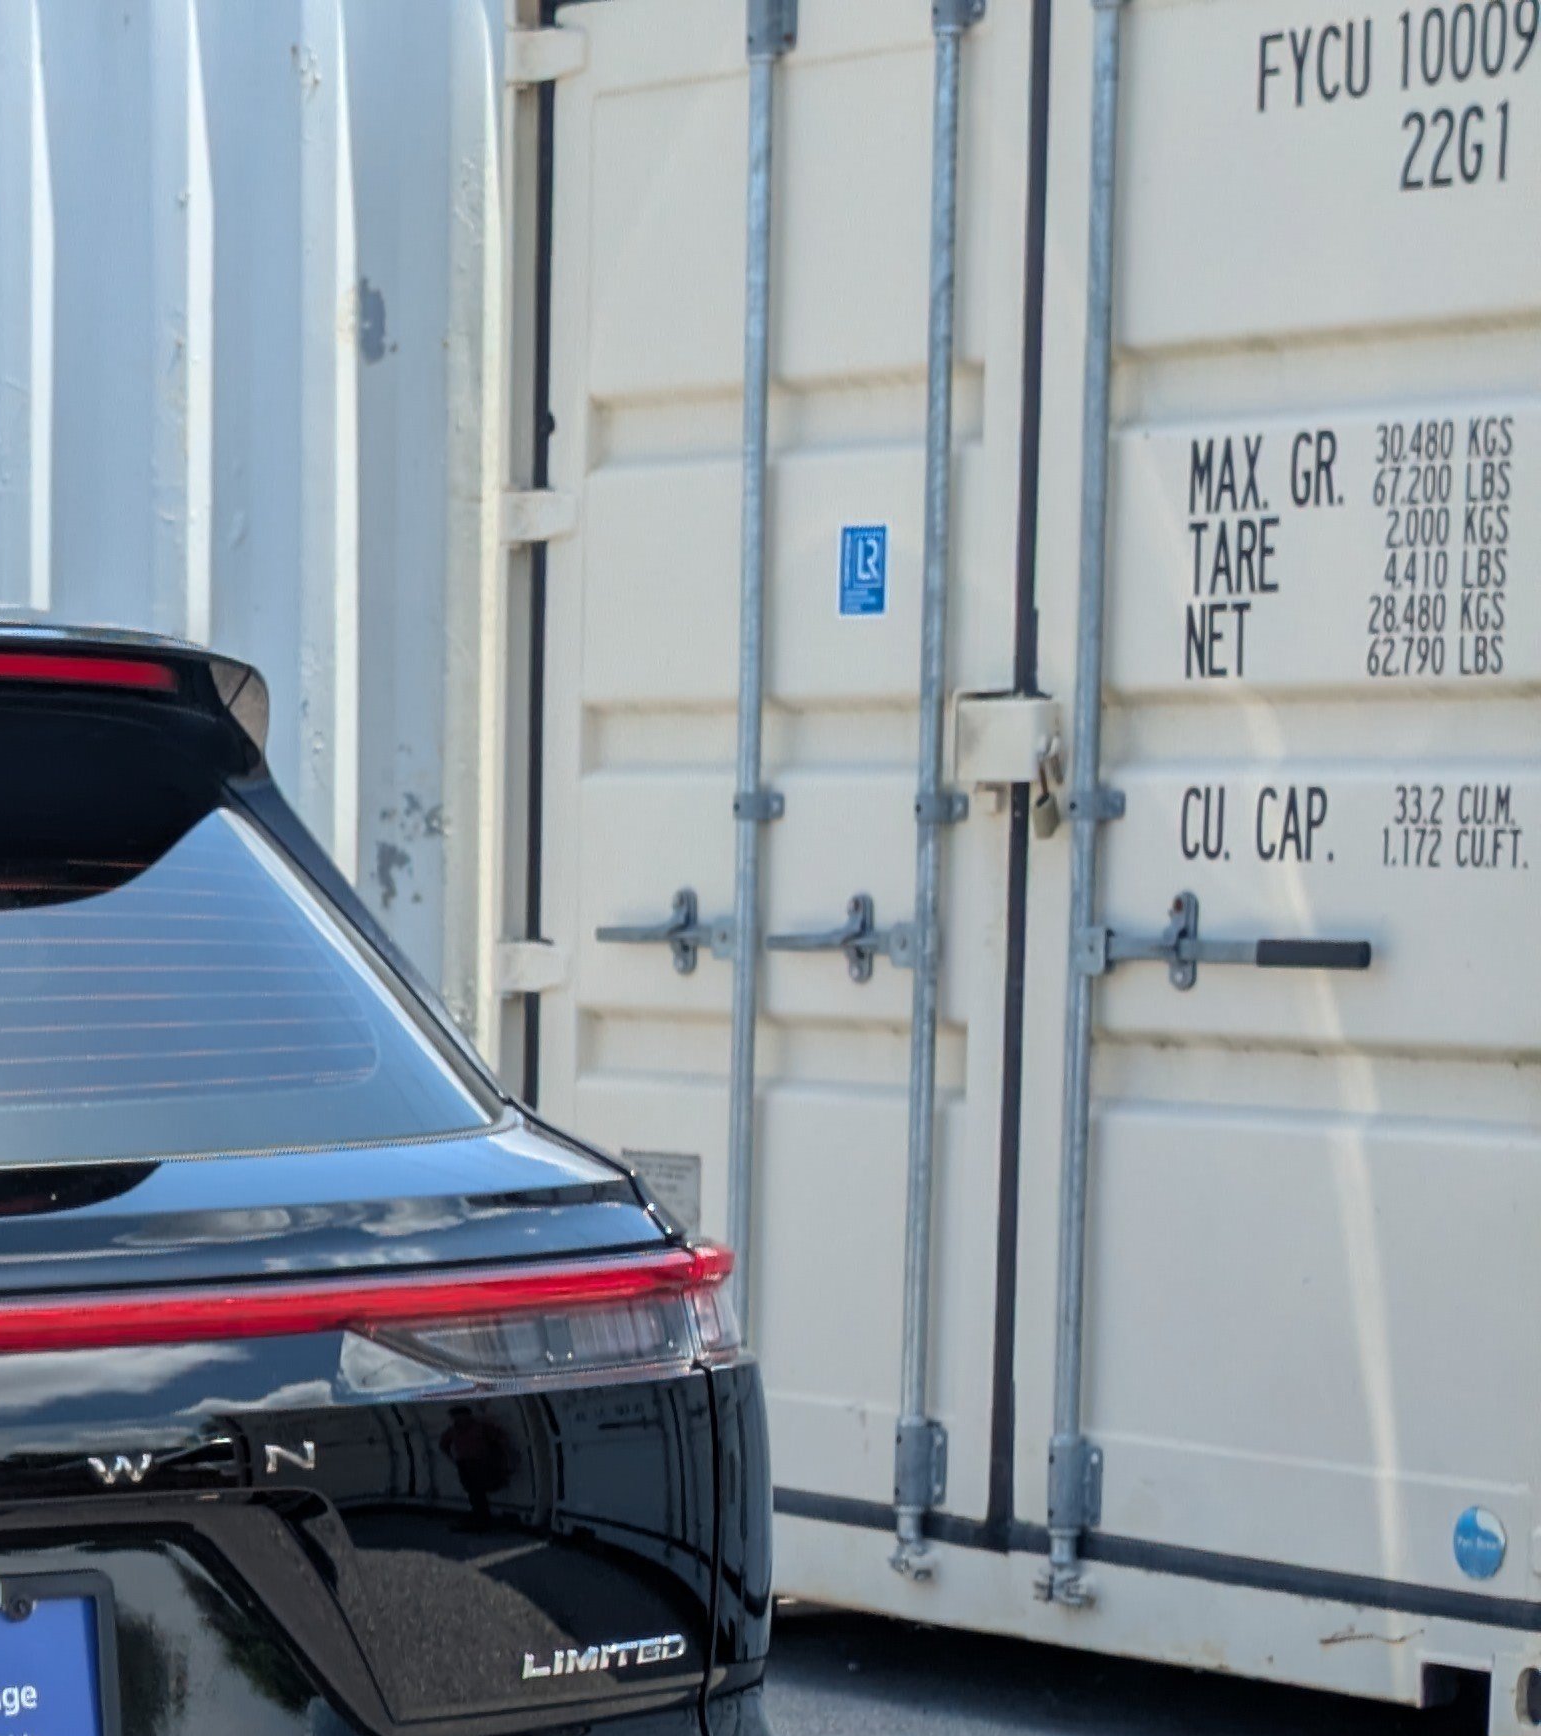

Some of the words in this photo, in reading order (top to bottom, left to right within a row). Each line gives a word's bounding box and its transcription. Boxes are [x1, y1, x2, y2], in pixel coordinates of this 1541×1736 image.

[1257, 16, 1373, 114] FYCU
[1399, 98, 1511, 192] 22G1
[1375, 419, 1454, 464] 30.480
[1467, 415, 1514, 457] KGS
[1188, 434, 1269, 514] MAX.
[1290, 429, 1344, 508] GR.
[1372, 463, 1452, 507] 67.200
[1465, 461, 1512, 503] LBS
[1385, 506, 1450, 549] 2.000
[1463, 504, 1509, 545] KGS
[1188, 516, 1280, 596] TARE
[1383, 550, 1448, 590] 4.410
[1462, 548, 1507, 588] LBS
[1368, 593, 1447, 635] 28.480
[1460, 591, 1505, 632] KGS
[1184, 602, 1252, 679] NET
[1366, 636, 1445, 677] 62.790
[1459, 635, 1504, 675] LBS
[1180, 785, 1231, 861] CU.
[1256, 785, 1335, 862] CAP.
[1394, 784, 1445, 825] 33.2
[1383, 827, 1443, 868] 1.172
[521, 1633, 687, 1680] LIMITED
